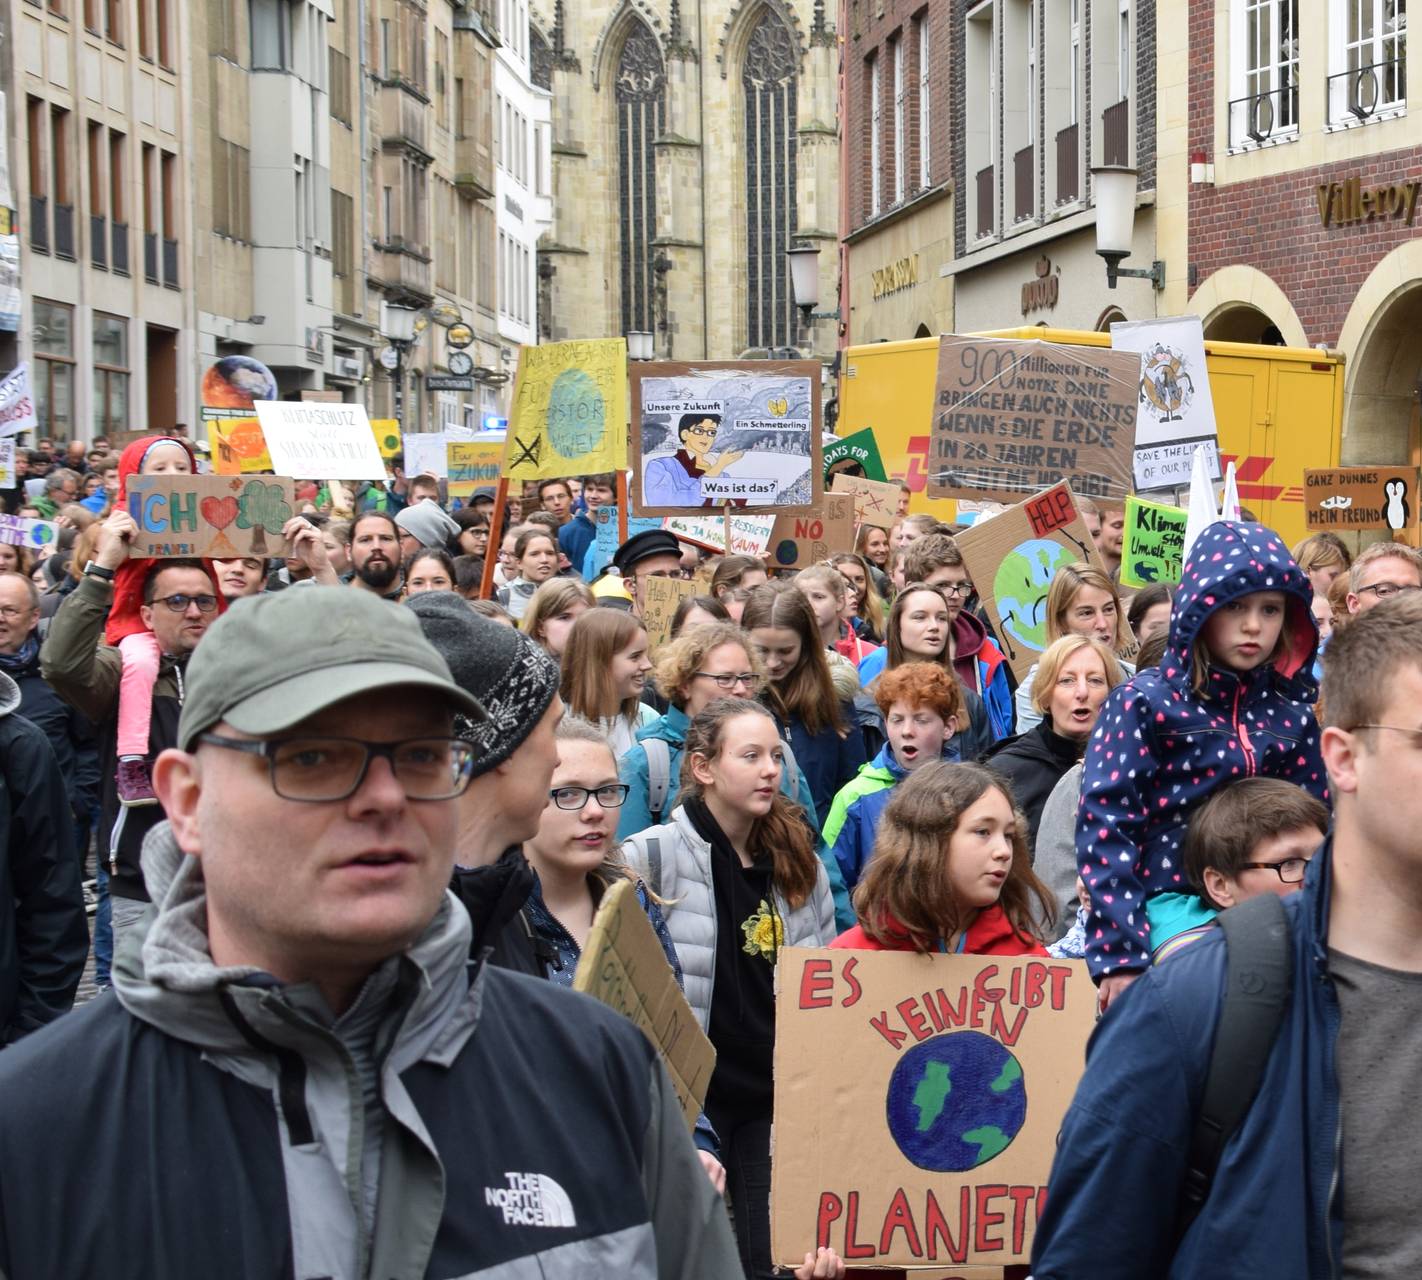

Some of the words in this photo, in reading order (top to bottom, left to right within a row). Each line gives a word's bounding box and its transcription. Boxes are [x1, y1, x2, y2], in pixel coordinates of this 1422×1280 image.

[1317, 176, 1422, 228] Villeroy
[958, 347, 1018, 389] 900
[1016, 377, 1058, 393] NOTRE
[1065, 381, 1110, 399] DAME
[647, 403, 681, 412] Unsere
[683, 402, 721, 411] Zukunft
[939, 390, 1016, 411] BRINGEN
[1018, 394, 1068, 417] AUCH
[1072, 401, 1136, 425] NICHTS
[750, 421, 807, 430] Schmetterling
[1011, 416, 1045, 440] DIE
[1053, 419, 1117, 448] ERDE
[850, 446, 870, 460] FOR
[938, 438, 958, 459] IN
[962, 442, 987, 460] 20
[994, 442, 1077, 469] JAHREN
[1137, 448, 1160, 462] SAVE
[1143, 466, 1155, 479] OF
[1161, 462, 1180, 476] OUR
[1306, 474, 1333, 487] GANZ
[732, 483, 745, 493] ist
[129, 492, 198, 533] ICH
[1031, 491, 1071, 535] HELP
[1308, 509, 1337, 524] MEIN
[1342, 508, 1381, 523] FREUND
[794, 519, 823, 540] NO
[799, 957, 863, 1009] ES
[974, 962, 1072, 1010] GIBT
[869, 986, 1029, 1050] KEINEN
[504, 1172, 540, 1192] THE
[484, 1186, 543, 1209] NORTH
[502, 1206, 544, 1226] FACE
